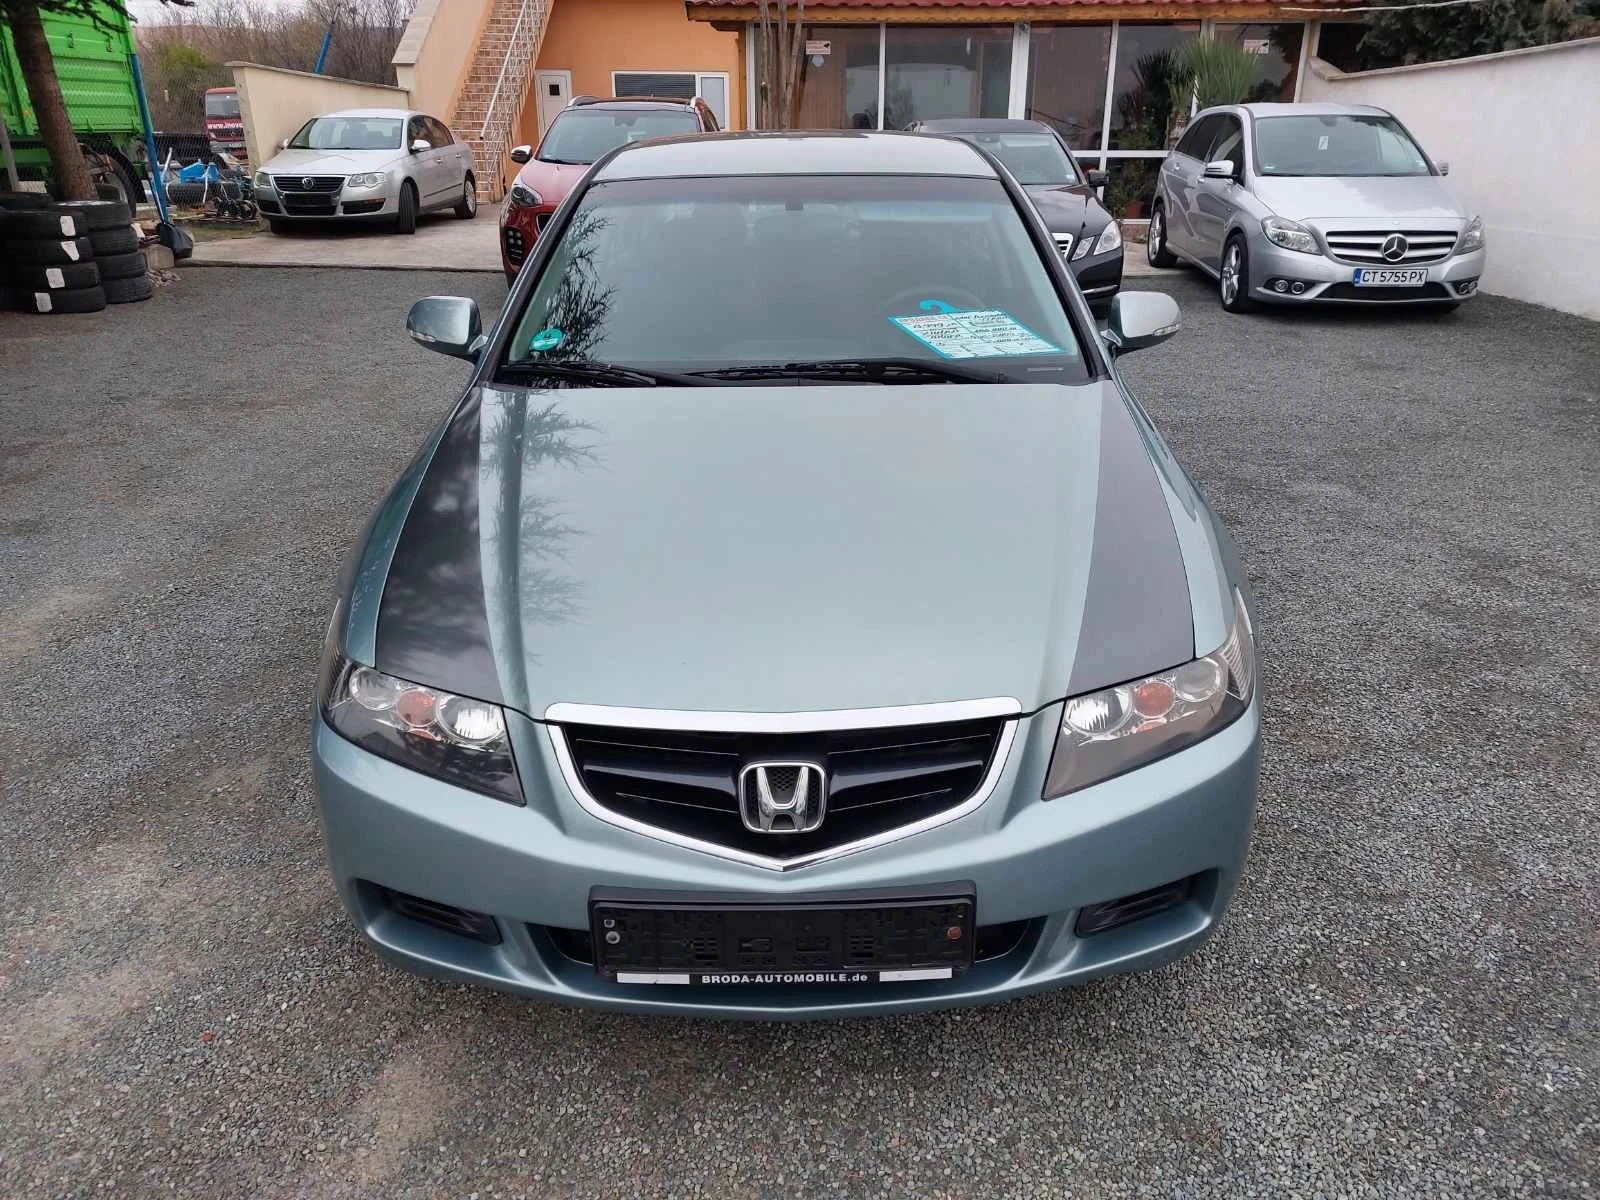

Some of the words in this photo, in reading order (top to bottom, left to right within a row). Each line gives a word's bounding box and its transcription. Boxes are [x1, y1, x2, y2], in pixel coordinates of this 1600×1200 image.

[1362, 271, 1379, 283] CT
[1380, 271, 1408, 283] 5755
[1409, 271, 1425, 283] PX
[701, 973, 869, 984] BRODA-AUTOMOBILE.de
